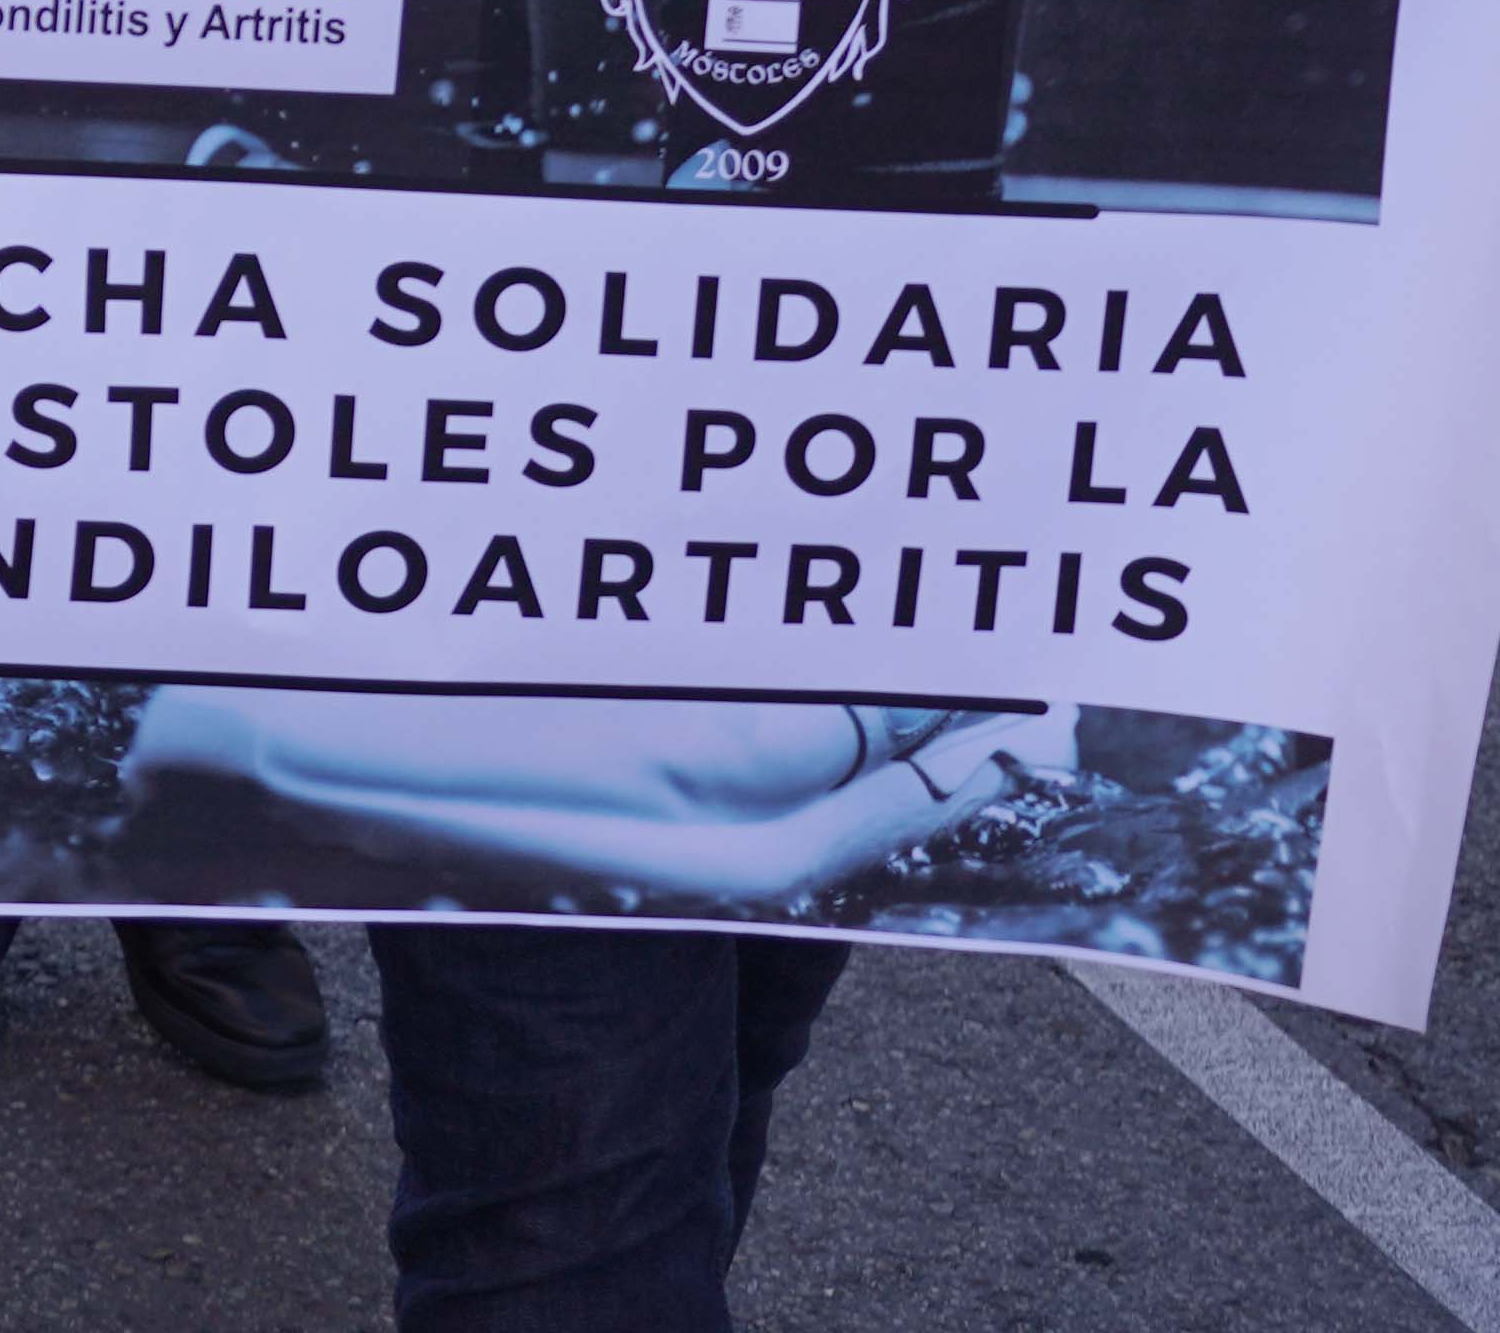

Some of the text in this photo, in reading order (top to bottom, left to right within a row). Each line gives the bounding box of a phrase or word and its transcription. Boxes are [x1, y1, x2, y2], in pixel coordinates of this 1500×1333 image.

[164, 10, 188, 46] y
[200, 3, 346, 45] Artritis
[693, 148, 790, 181] 2009
[368, 261, 1247, 378] SOLIDARIA
[680, 409, 987, 501] POR
[1068, 421, 1250, 514] LA
